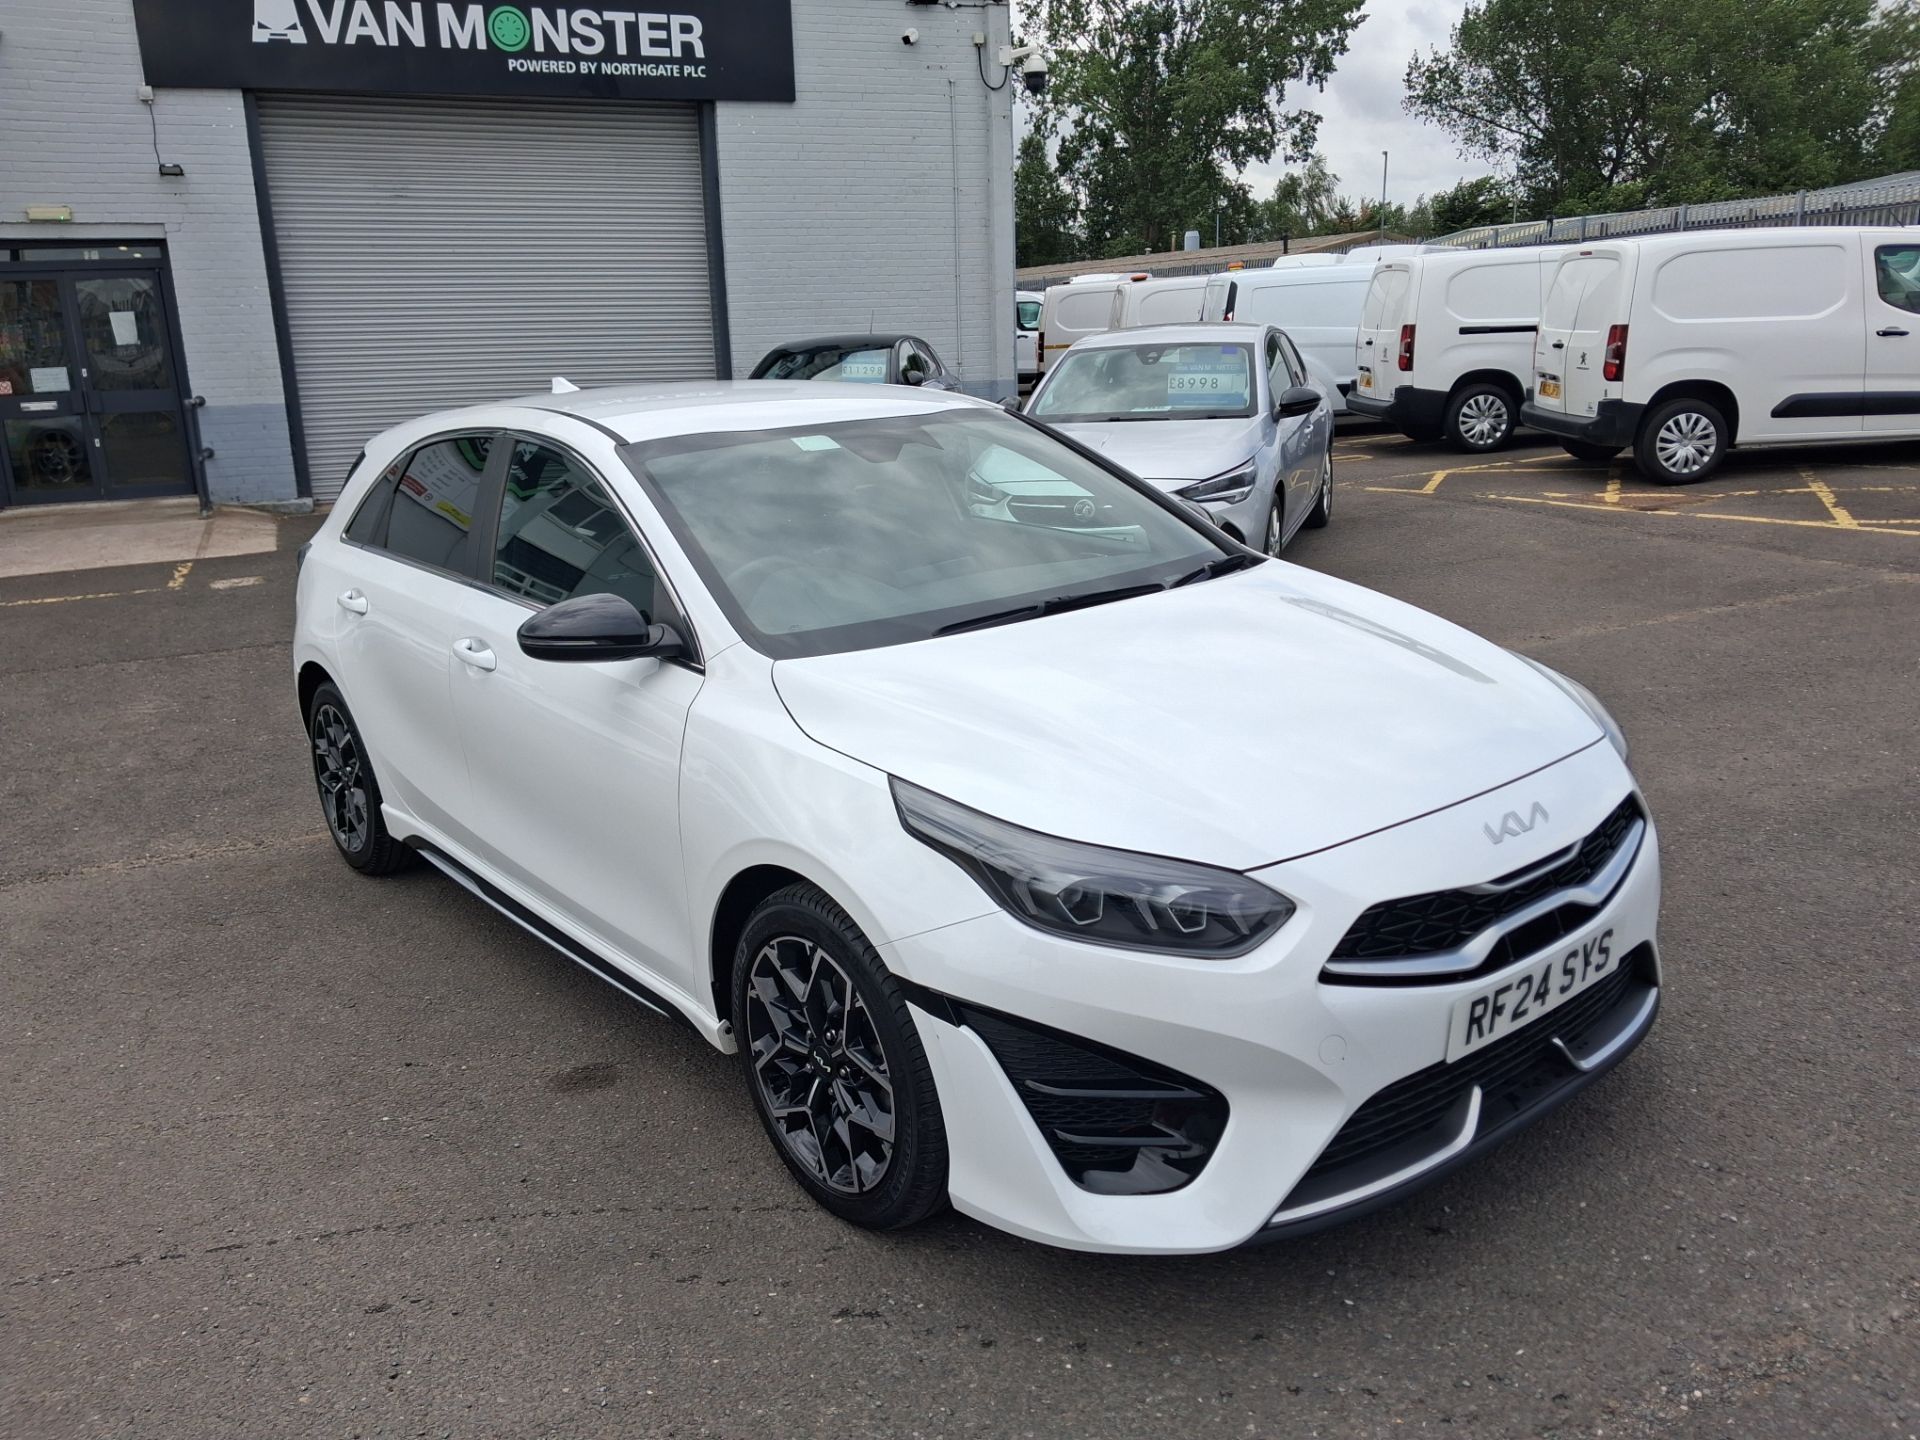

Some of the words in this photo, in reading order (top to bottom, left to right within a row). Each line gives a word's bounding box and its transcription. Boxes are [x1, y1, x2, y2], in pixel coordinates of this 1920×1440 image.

[306, 0, 426, 48] VAN
[436, 2, 705, 58] MONSTER
[507, 58, 576, 74] POWERED
[580, 61, 598, 75] BY
[601, 62, 681, 77] NORTHGATE
[683, 65, 707, 78] PLC
[1169, 377, 1219, 389] £8998
[1465, 962, 1553, 1046] RF24
[1559, 928, 1614, 995] SYS
